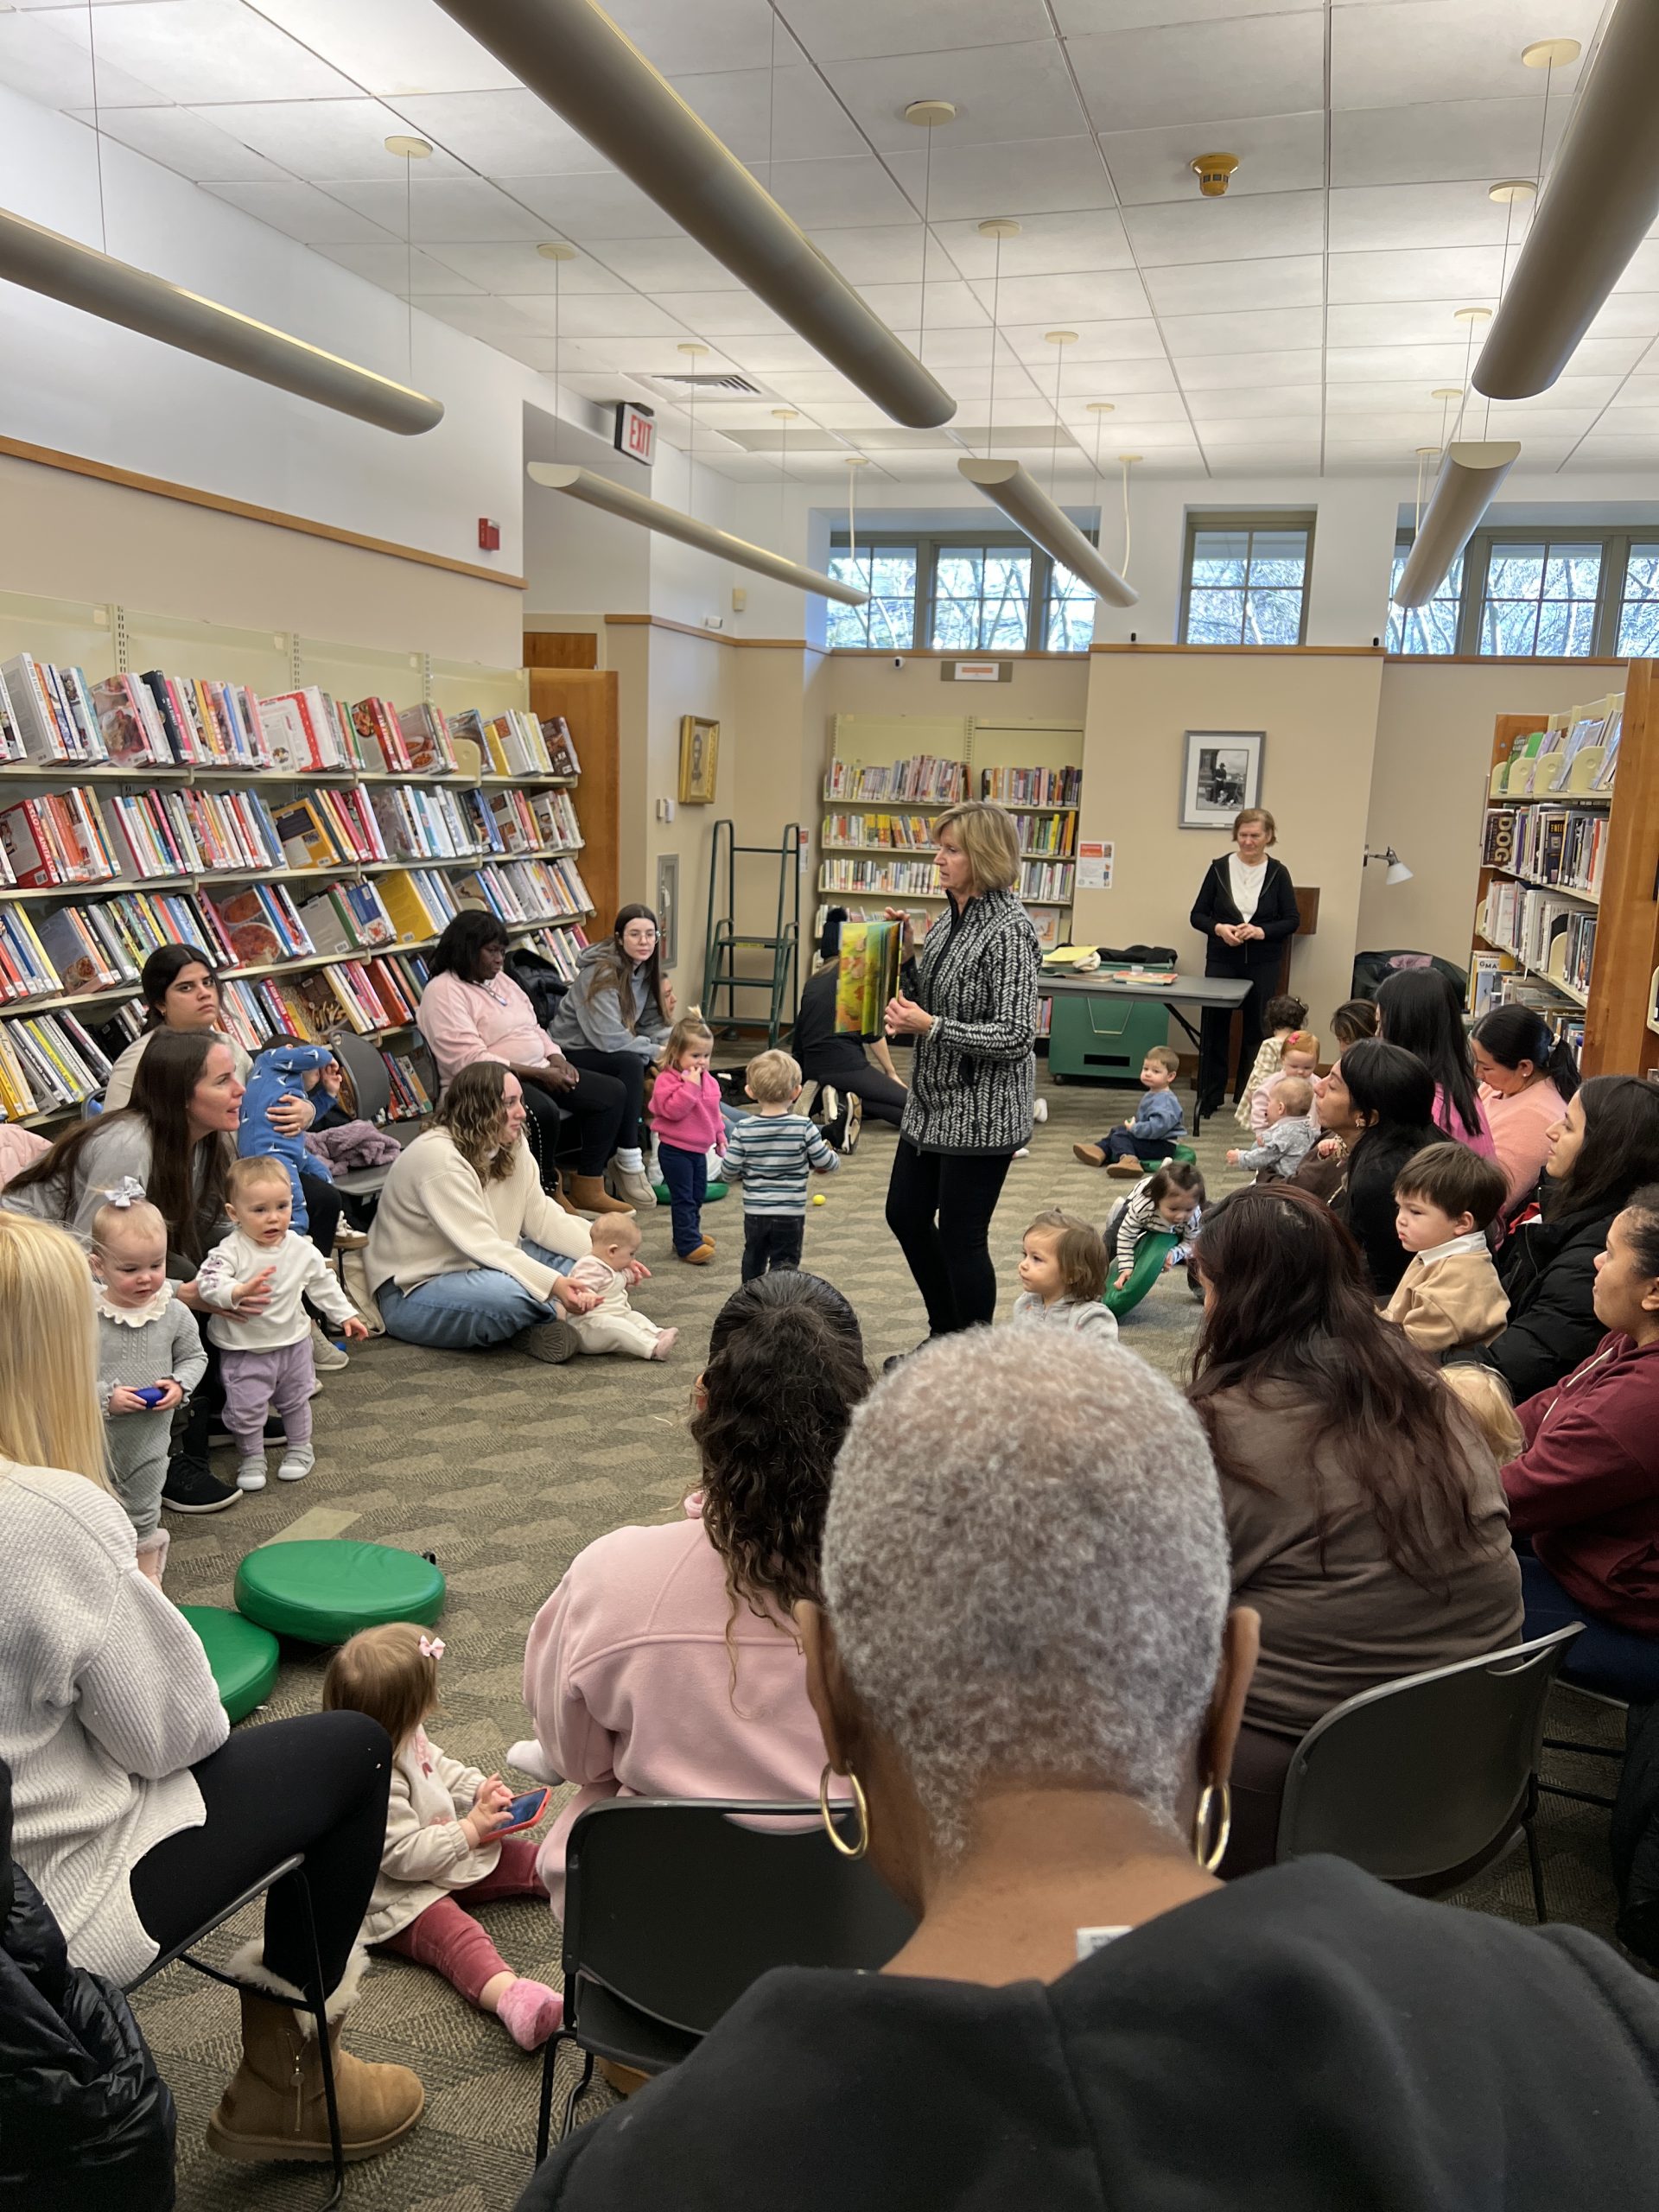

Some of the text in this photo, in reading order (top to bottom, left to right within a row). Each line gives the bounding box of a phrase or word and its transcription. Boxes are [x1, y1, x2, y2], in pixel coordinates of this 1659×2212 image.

[629, 415, 653, 457] EXIT
[38, 836, 51, 861] ANITA
[1494, 817, 1514, 862] DOG
